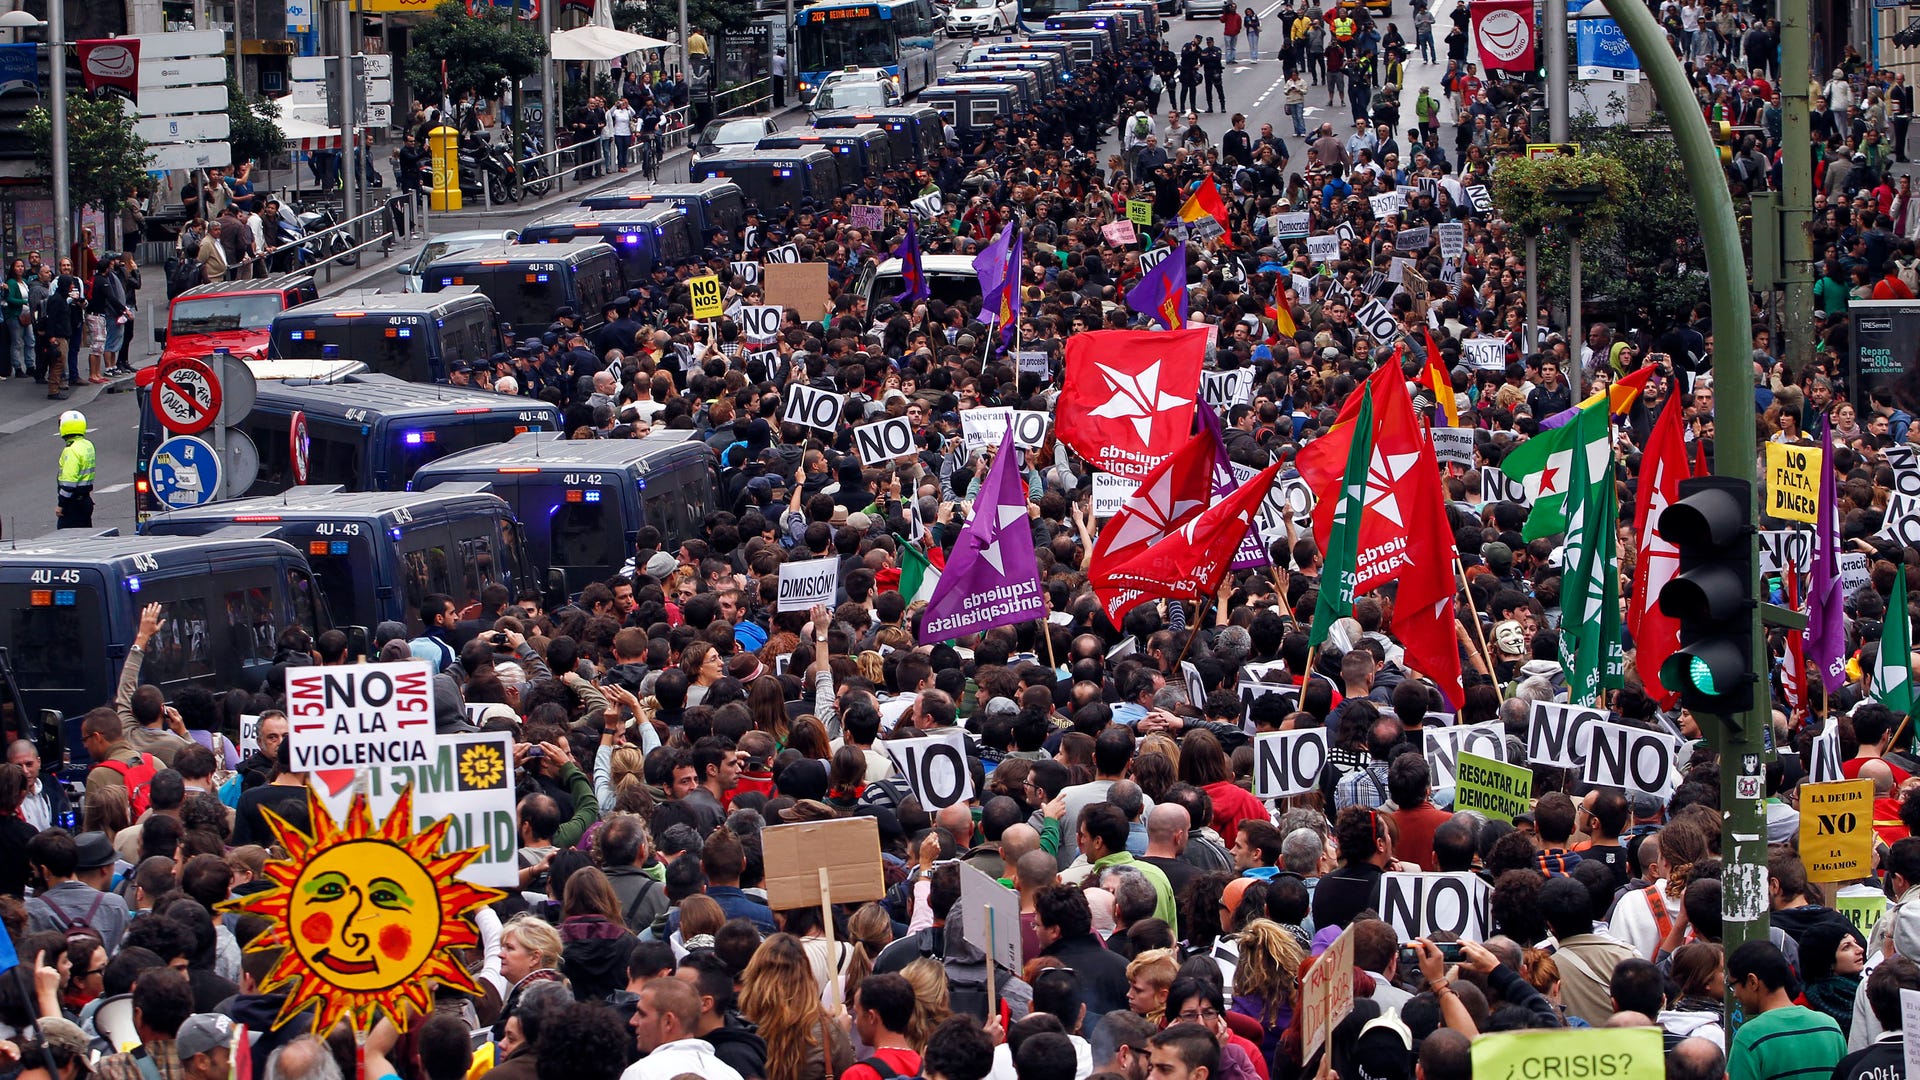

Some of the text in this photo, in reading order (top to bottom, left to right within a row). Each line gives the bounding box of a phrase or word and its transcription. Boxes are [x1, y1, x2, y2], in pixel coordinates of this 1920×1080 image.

[617, 225, 642, 233] 4U-16
[1279, 219, 1309, 231] Democracia
[528, 263, 554, 271] 4U-18
[692, 280, 717, 297] NO
[694, 295, 718, 308] NOS
[389, 316, 418, 325] 4U-19
[743, 308, 780, 335] NO
[1358, 300, 1396, 339] NO
[1861, 346, 1891, 357] Repara
[1875, 355, 1889, 367] 80
[1206, 373, 1238, 402] NO
[519, 410, 549, 421] 4U-40
[787, 387, 839, 428] NO
[964, 411, 1014, 422] Soberana
[858, 420, 910, 461] NO
[1433, 431, 1472, 444] Congreso más
[1435, 448, 1471, 461] esentativo!
[1786, 450, 1806, 472] NO
[563, 474, 602, 485] 4U-42
[1096, 475, 1142, 488] Soberan
[1776, 468, 1812, 492] FALTA
[1775, 489, 1816, 516] DINERO
[315, 522, 360, 535] 4U-43
[132, 553, 159, 572] 4U-45
[31, 569, 80, 583] 4U-45
[779, 573, 835, 600] DIMISIÓN!
[324, 670, 393, 709] NO
[395, 671, 429, 730] 15M
[291, 675, 325, 734] 15M
[333, 712, 386, 735] A LA
[296, 740, 427, 767] VIOLENCIA
[1259, 731, 1326, 795] NO
[1425, 728, 1504, 788] NO
[1587, 728, 1669, 792] NO
[1459, 762, 1528, 799] RESCATAR LA
[1460, 787, 1525, 820] DEMOCRACIA
[1811, 791, 1863, 804] LA DEUDA
[1817, 812, 1857, 836] NO
[1829, 849, 1842, 858] LA
[1813, 860, 1858, 872] PAGAMOS
[1384, 877, 1469, 941] NO
[1506, 1053, 1633, 1080] ¿CRISIS?
